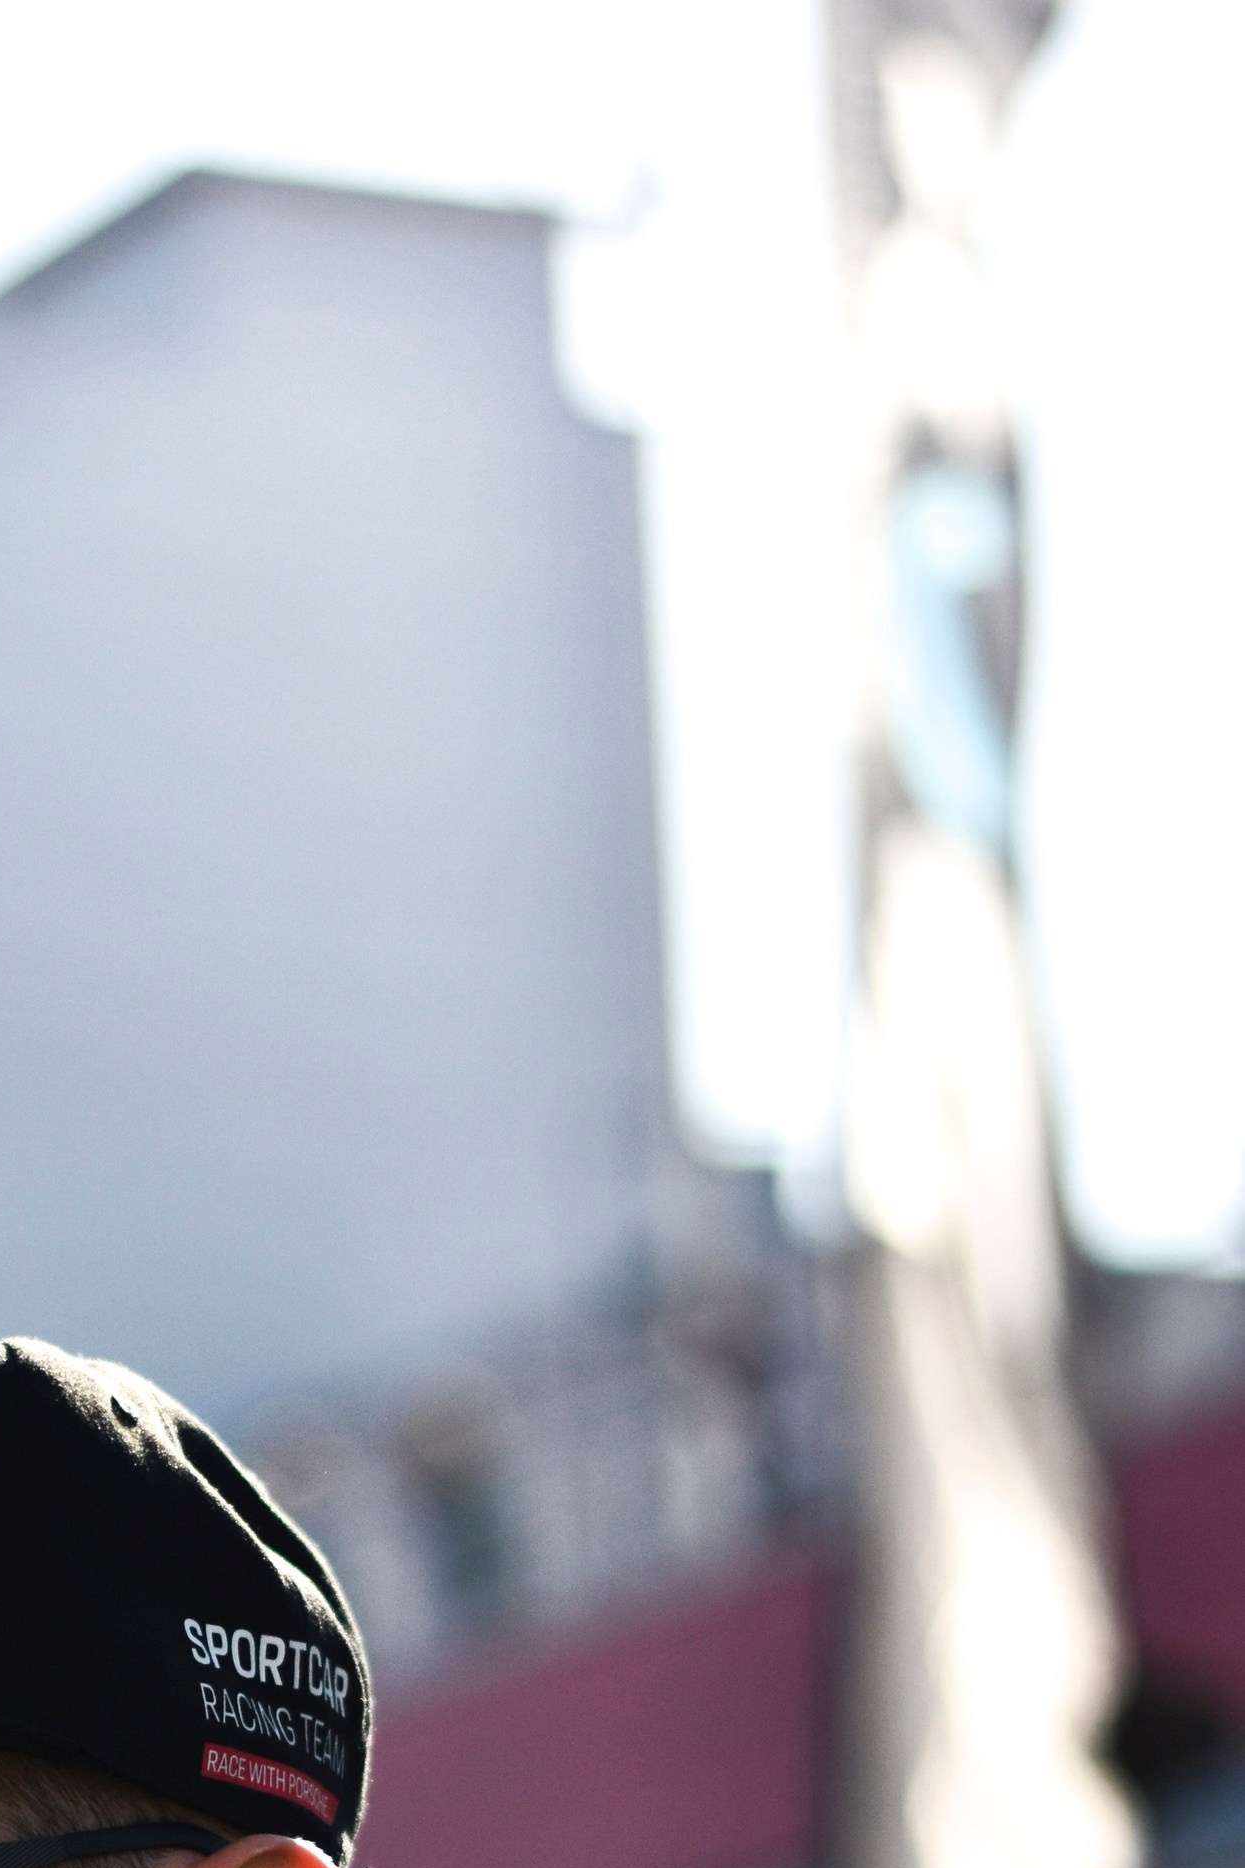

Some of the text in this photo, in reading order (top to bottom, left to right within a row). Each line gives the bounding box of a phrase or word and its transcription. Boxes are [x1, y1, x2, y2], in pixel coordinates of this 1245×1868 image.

[184, 1617, 349, 1718] SPORTCAR
[199, 1682, 345, 1779] RACING TEAM
[206, 1749, 329, 1818] RACE WITH PORSCHE
